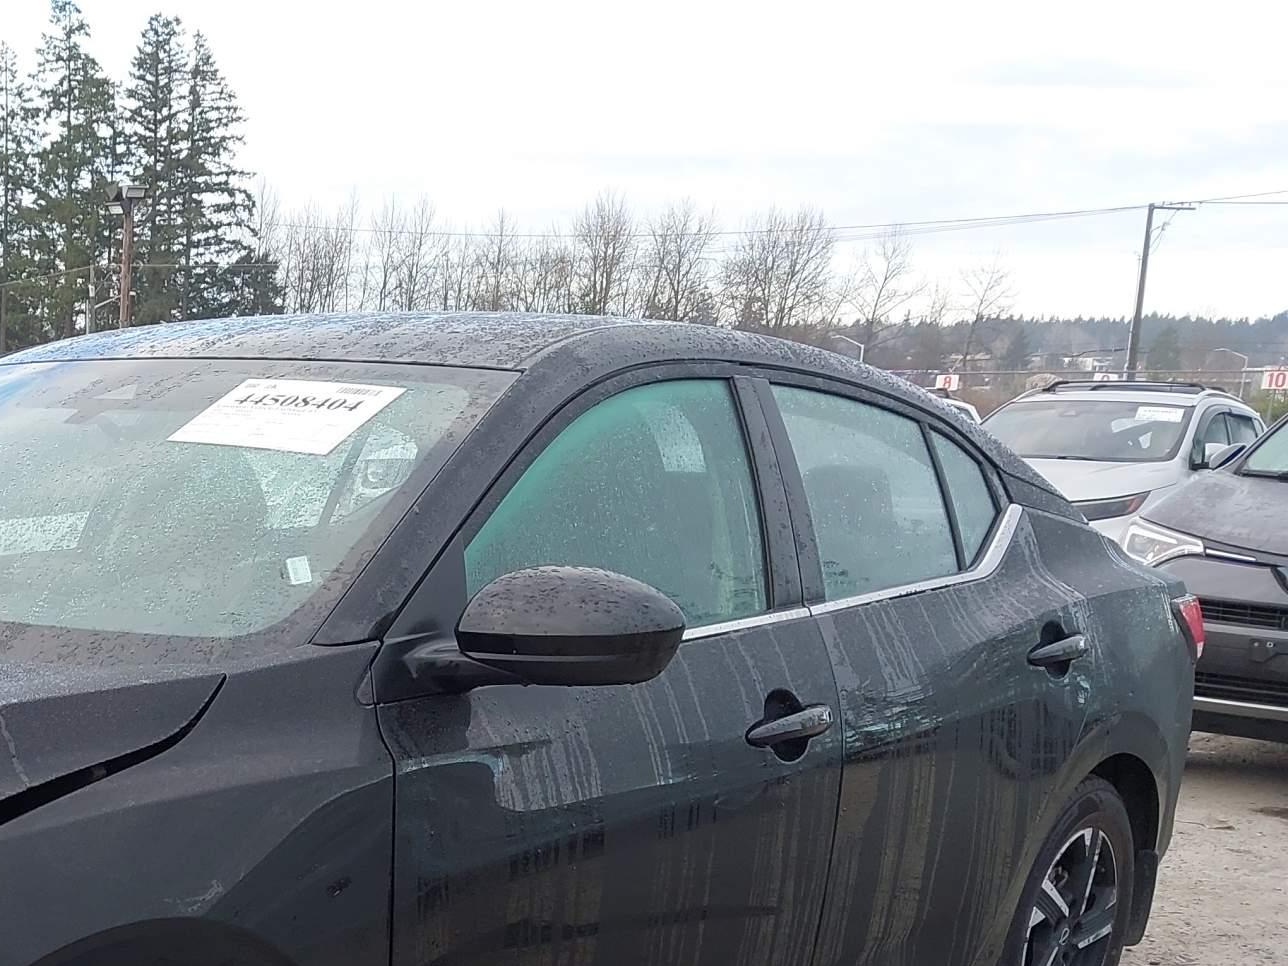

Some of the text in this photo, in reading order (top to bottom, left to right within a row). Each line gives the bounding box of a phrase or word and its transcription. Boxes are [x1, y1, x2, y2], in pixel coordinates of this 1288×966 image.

[943, 375, 952, 389] 8
[1267, 372, 1287, 388] 10
[234, 393, 365, 411] 44508404
